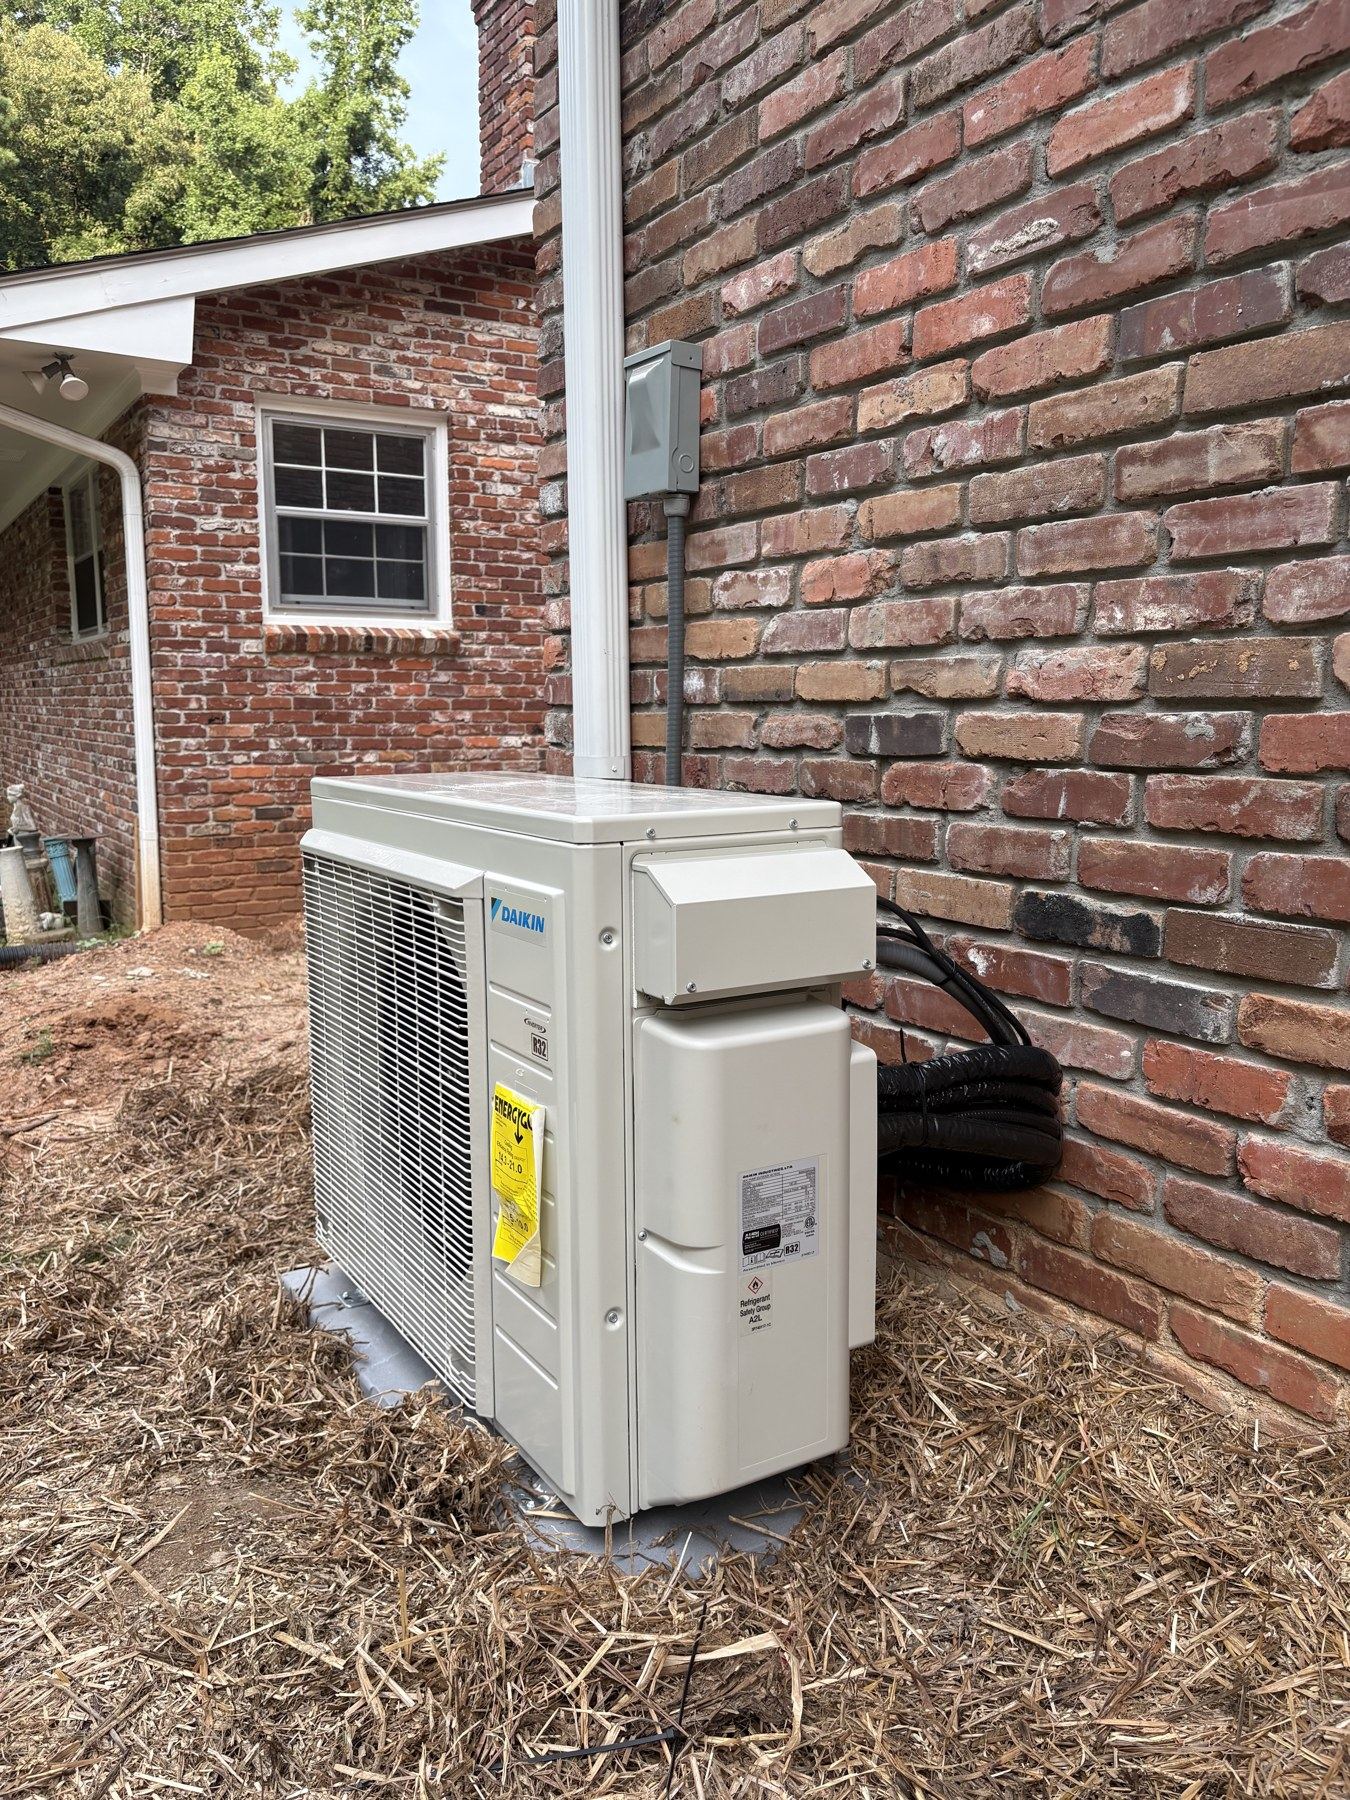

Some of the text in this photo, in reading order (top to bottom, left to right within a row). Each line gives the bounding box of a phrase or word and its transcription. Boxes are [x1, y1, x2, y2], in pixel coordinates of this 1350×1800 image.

[502, 906, 545, 932] DAIKIN
[533, 1037, 547, 1058] R32
[785, 1244, 799, 1255] R32
[740, 1294, 771, 1308] Refrigerant
[740, 1304, 771, 1317] Safety Group
[749, 1315, 762, 1324] A2L
